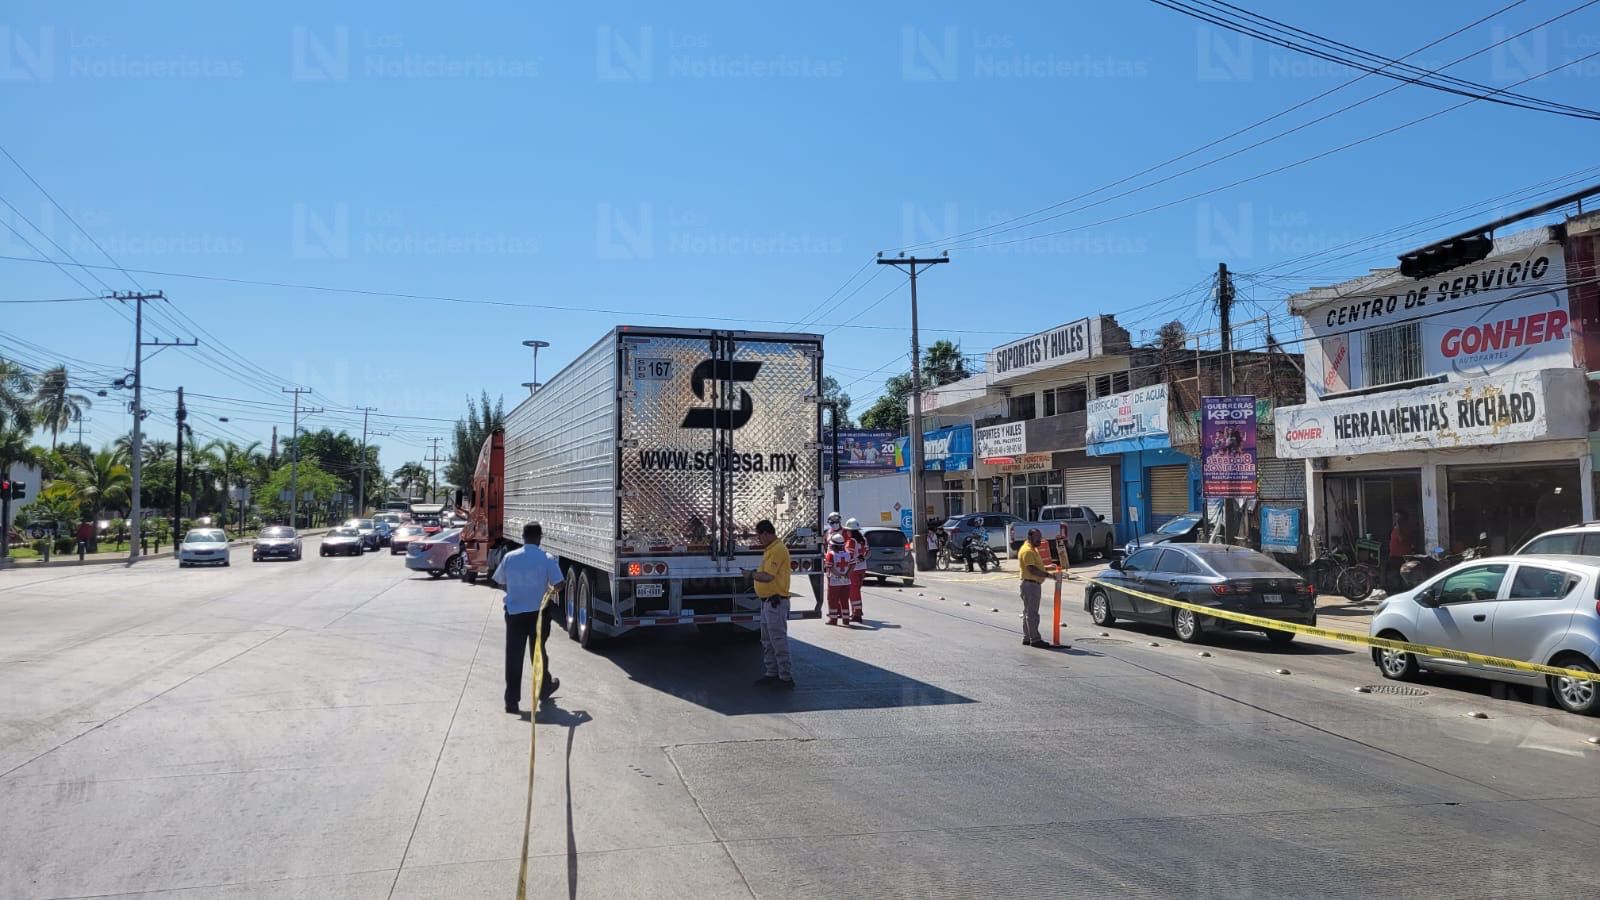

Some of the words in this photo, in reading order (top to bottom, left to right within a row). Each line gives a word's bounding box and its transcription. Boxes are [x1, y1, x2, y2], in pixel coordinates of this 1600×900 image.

[1327, 296, 1398, 328] CENTRO
[1404, 286, 1430, 310] DE
[1437, 256, 1550, 302] SERVICIO
[1441, 309, 1569, 359] GONHER
[997, 338, 1041, 374] SOPORTES
[1042, 334, 1049, 361] Y
[1051, 325, 1084, 359] HULES
[648, 361, 671, 377] 167
[1134, 392, 1144, 404] DE
[1145, 388, 1166, 401] AGUA
[1334, 403, 1449, 440] HERRAMIENTAS
[1457, 391, 1536, 428] RICHARD
[1005, 424, 1022, 437] HULES
[1286, 427, 1323, 442] GONHER
[639, 450, 798, 472] www.sodesa.mx
[1203, 464, 1256, 473] NOVIEMBRE
